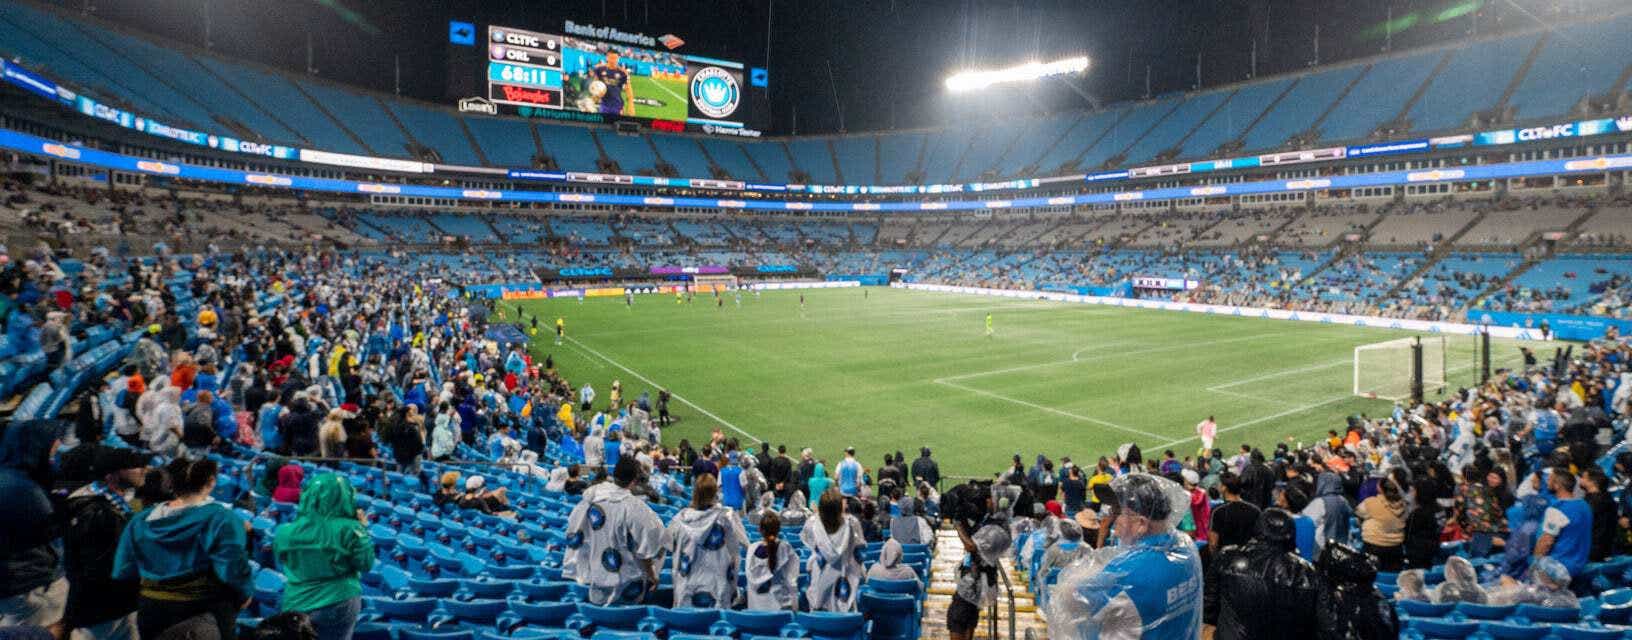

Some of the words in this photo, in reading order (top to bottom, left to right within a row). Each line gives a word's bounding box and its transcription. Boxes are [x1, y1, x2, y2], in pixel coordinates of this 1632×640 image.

[565, 20, 597, 36] Bank
[598, 25, 609, 39] of
[609, 27, 656, 47] America
[547, 39, 556, 50] 0
[506, 50, 530, 62] ORL
[547, 55, 556, 66] 0
[501, 65, 547, 85] 68:11
[534, 107, 570, 119] Atrium
[572, 110, 603, 122] Health
